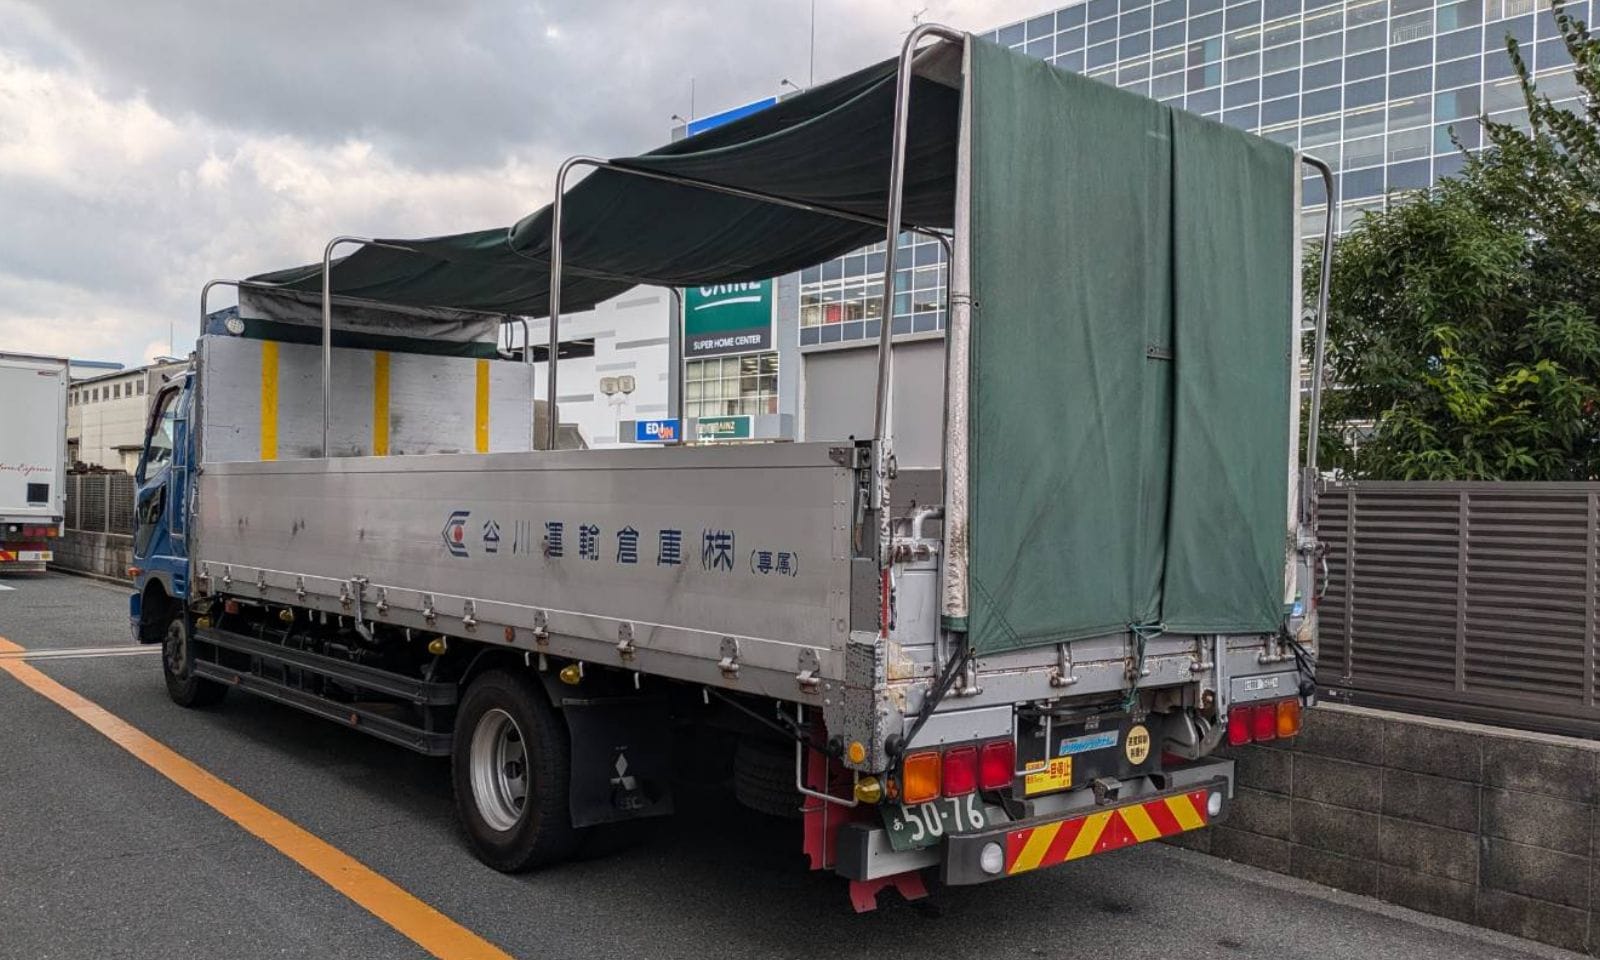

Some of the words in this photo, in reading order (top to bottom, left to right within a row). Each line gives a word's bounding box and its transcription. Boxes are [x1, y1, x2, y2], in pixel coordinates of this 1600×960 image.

[693, 339, 713, 351] SUPER
[714, 337, 734, 348] HOME
[735, 334, 761, 346] CENTER
[749, 549, 799, 577] (専属)
[893, 818, 904, 831] あ
[902, 793, 985, 841] 50-76
